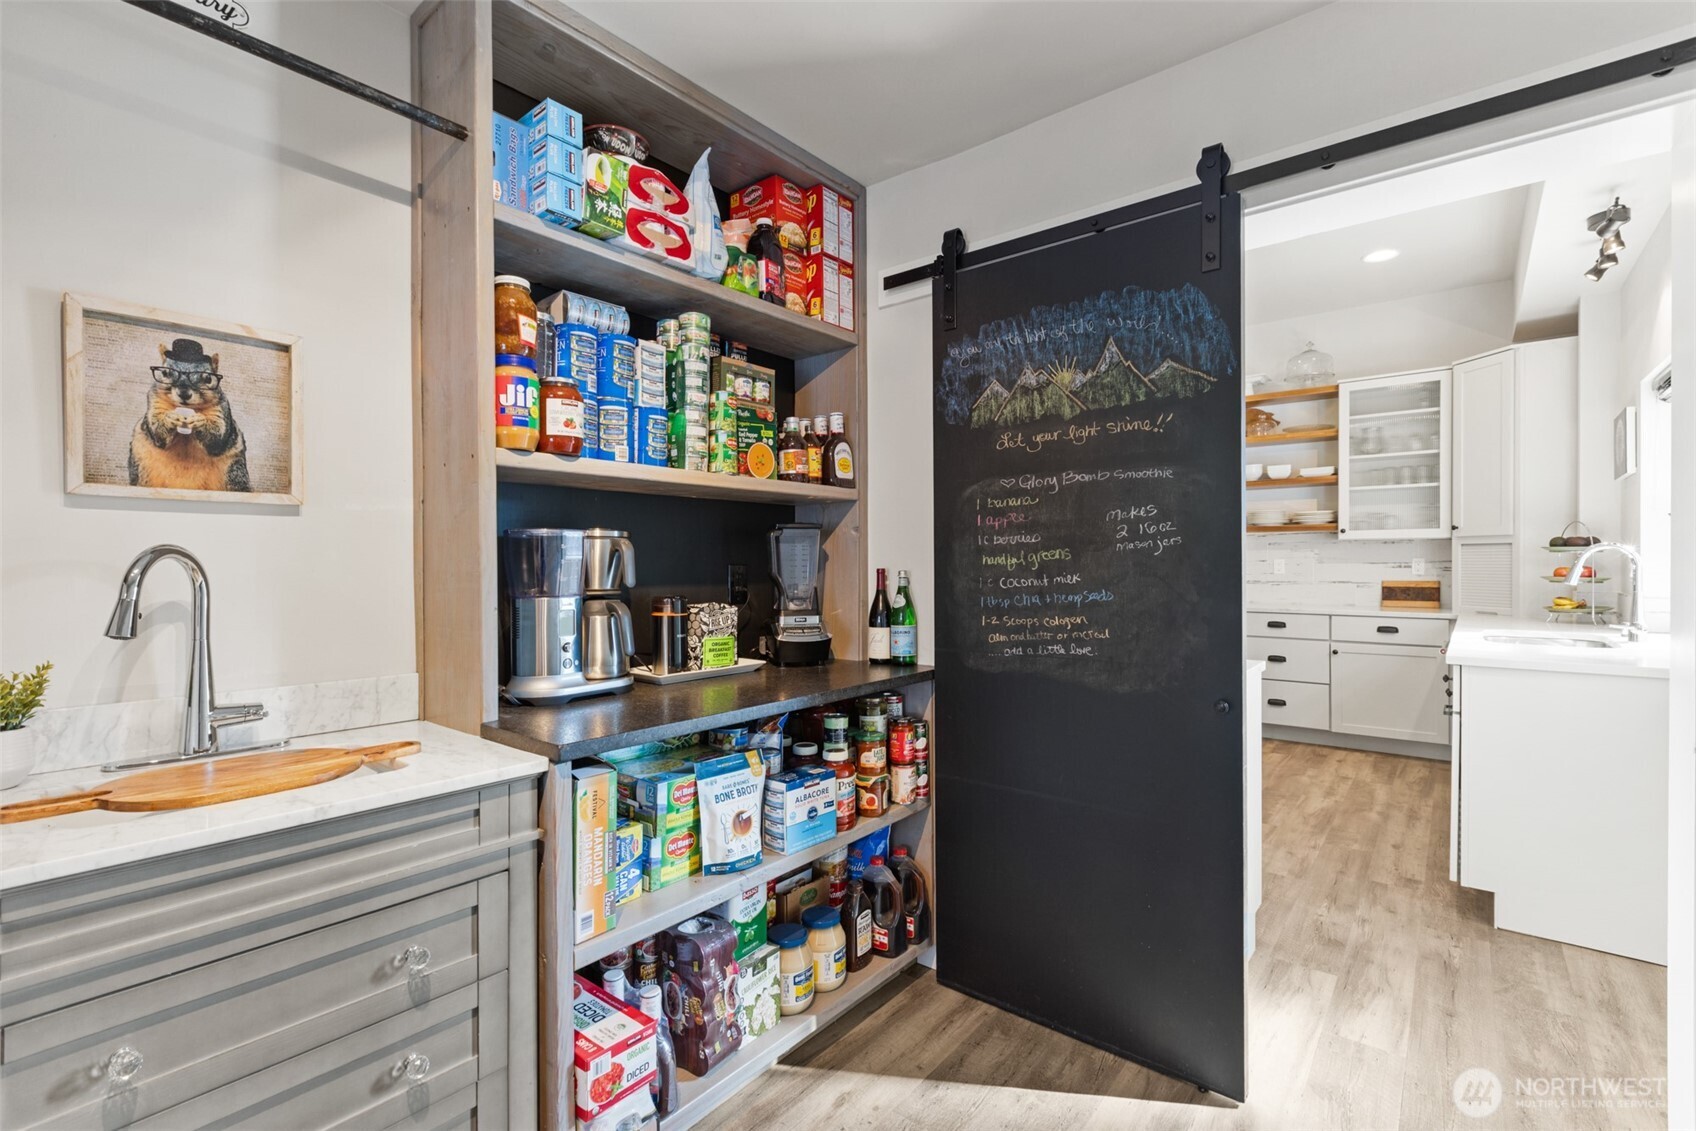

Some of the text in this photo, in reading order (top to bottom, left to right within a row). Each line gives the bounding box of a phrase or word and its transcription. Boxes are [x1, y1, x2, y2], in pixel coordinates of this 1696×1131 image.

[611, 139, 632, 156] UDON
[508, 127, 519, 206] Sandwich Bags
[499, 384, 538, 408] Jif
[996, 431, 1026, 451] Let
[1025, 429, 1062, 452] your
[1062, 421, 1102, 445] light
[1019, 466, 1174, 494] Glory Bomb Smoothie
[987, 496, 1040, 508] banana
[986, 512, 1032, 530] apple
[994, 531, 1042, 545] berries
[1116, 524, 1129, 538] 2
[1028, 548, 1072, 570] greens
[1000, 573, 1049, 588] coconut
[1054, 572, 1082, 584] milk
[982, 615, 1000, 626] 1-2
[1056, 632, 1068, 640] or
[647, 786, 654, 797] 12
[714, 790, 736, 804] BONE
[794, 786, 830, 804] ALBACORE
[582, 834, 593, 887] ORANGES
[593, 826, 604, 886] MANDARIN
[620, 872, 628, 891] CAN
[628, 868, 640, 879] 4
[858, 924, 872, 936] RAW
[574, 1002, 606, 1023] DICED
[626, 1042, 651, 1061] ORGANIC
[626, 1062, 650, 1082] DICED
